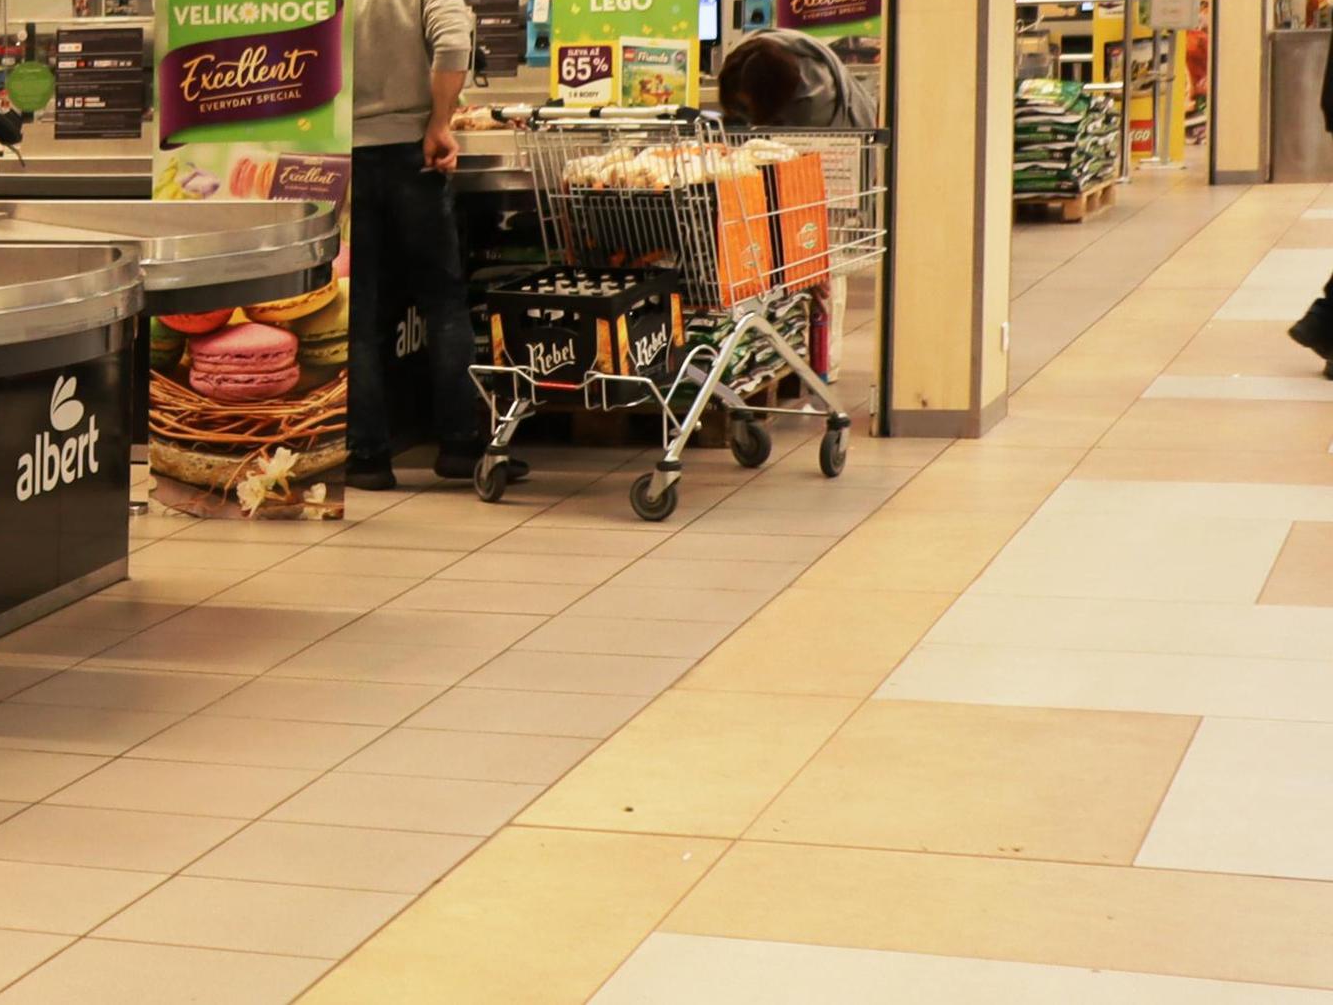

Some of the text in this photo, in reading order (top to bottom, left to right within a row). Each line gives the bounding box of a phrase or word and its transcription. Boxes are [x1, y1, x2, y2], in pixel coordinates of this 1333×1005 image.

[173, 0, 330, 26] VELIKONOCE
[180, 45, 318, 102] Excellent
[562, 57, 609, 81] 65%
[199, 89, 302, 114] EVERYDAY SPECIAL
[396, 305, 428, 358] alb
[635, 322, 668, 368] Rebel
[526, 338, 576, 376] Rebel
[17, 414, 100, 502] albert
